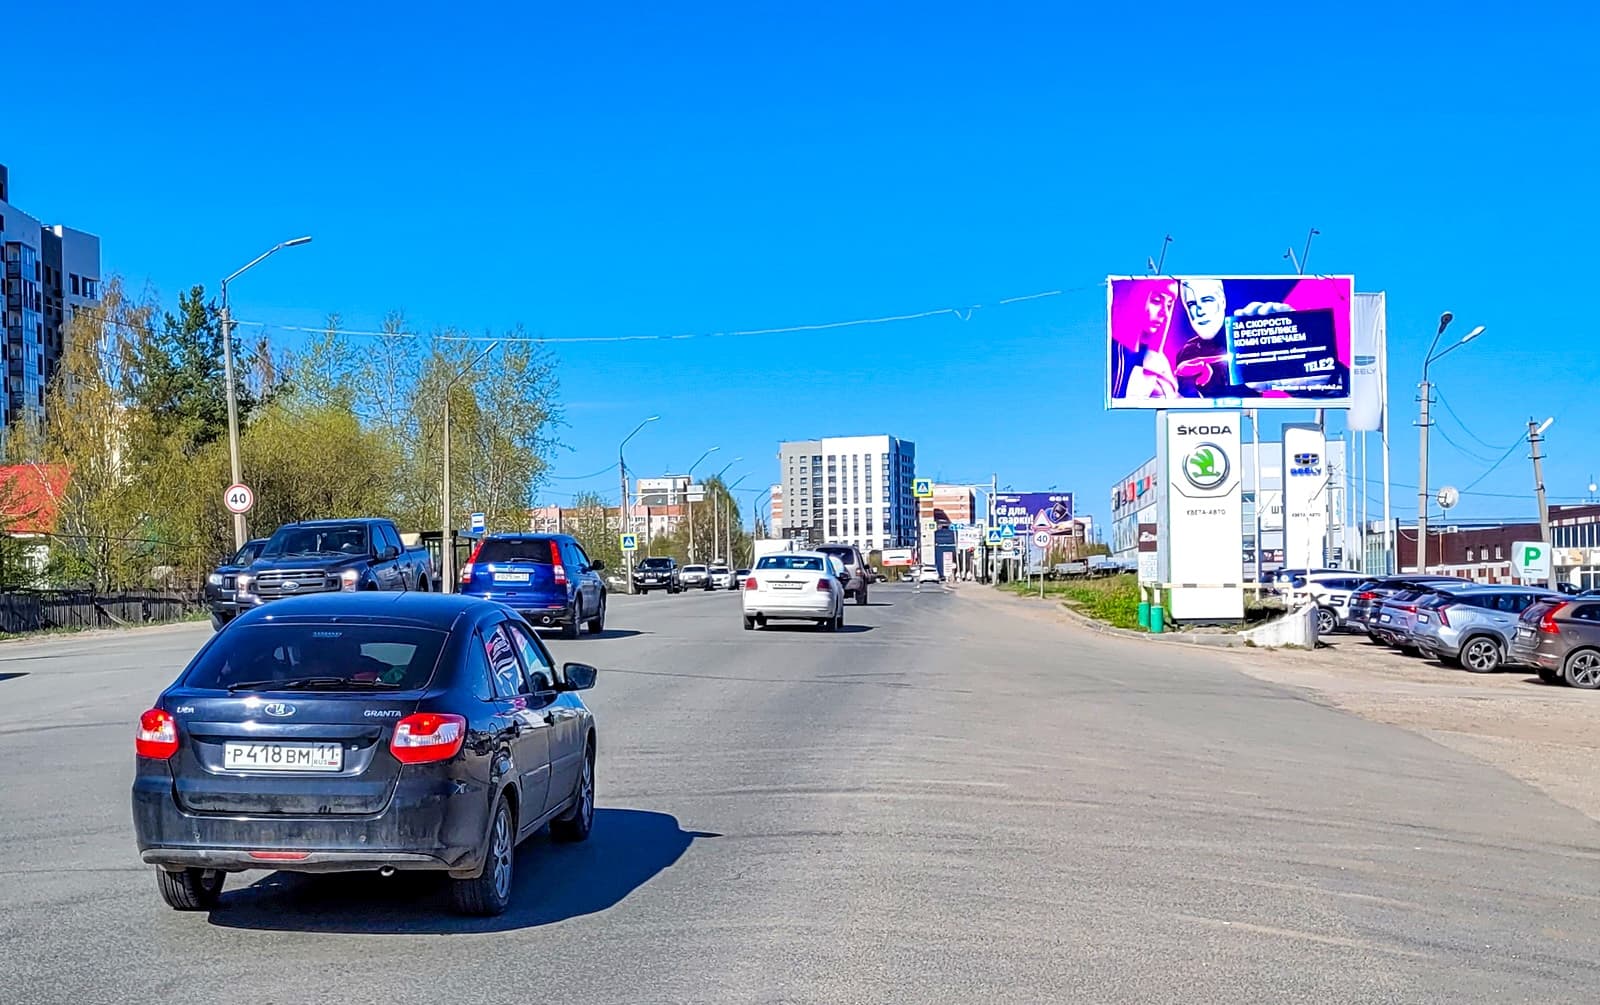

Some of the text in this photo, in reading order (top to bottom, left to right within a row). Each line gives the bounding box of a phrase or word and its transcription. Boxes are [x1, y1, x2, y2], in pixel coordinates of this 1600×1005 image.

[1232, 317, 1292, 330] ЗА СКОРОСТЬ
[1234, 325, 1298, 338] В РЕСПУБЛИКЕ
[1234, 333, 1306, 347] КОМИ ОТВЕЧАЕМ
[1304, 357, 1335, 372] TELE2
[1354, 367, 1376, 375] EELY
[230, 493, 247, 504] 40
[1036, 534, 1048, 543] 40
[1524, 547, 1541, 566] P
[363, 708, 402, 718] GRANTA
[316, 745, 336, 760] 11
